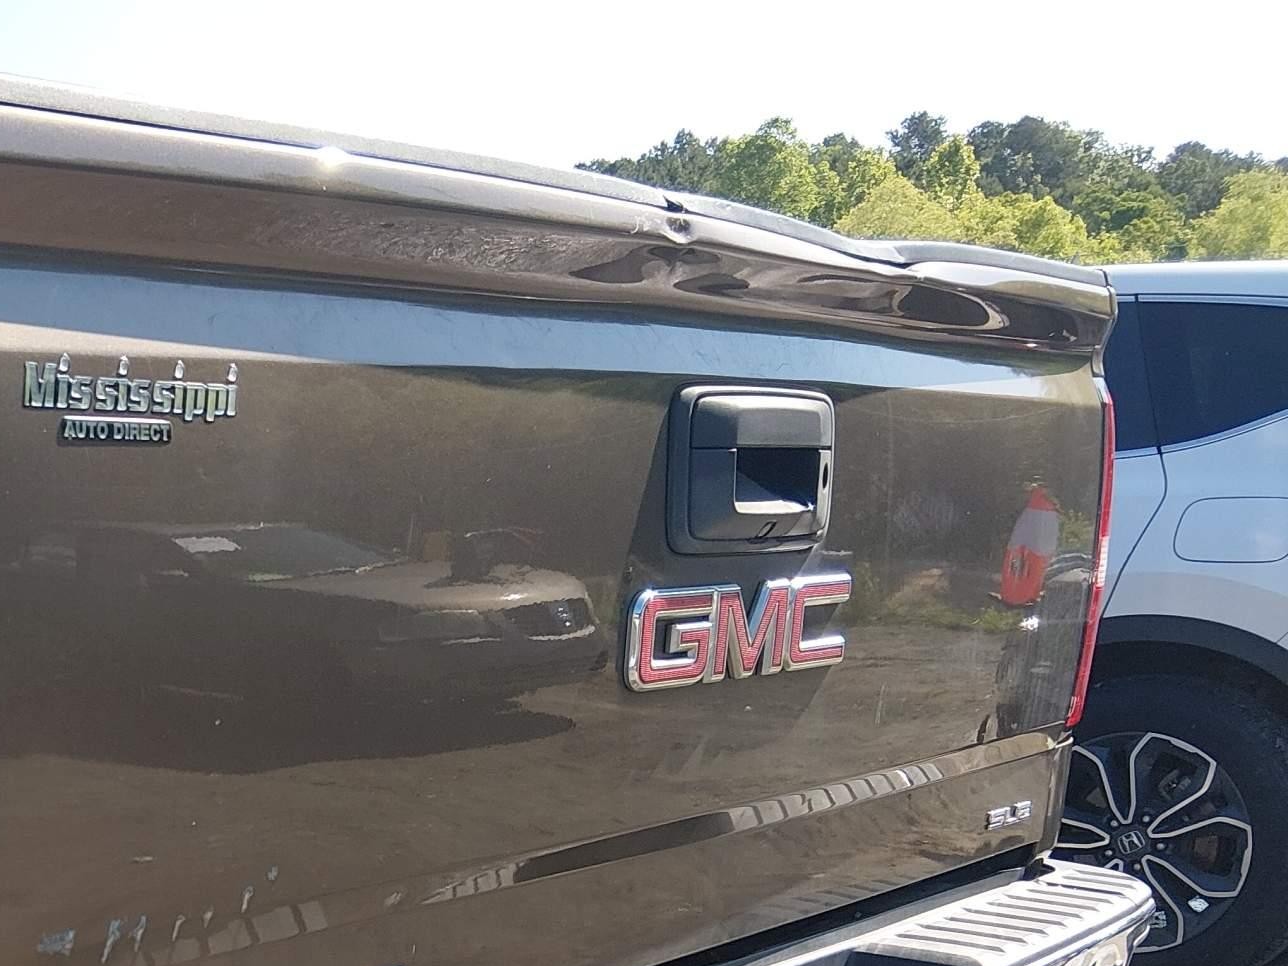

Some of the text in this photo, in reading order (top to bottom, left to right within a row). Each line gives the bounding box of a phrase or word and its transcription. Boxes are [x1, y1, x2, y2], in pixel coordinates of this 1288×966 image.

[23, 352, 238, 422] Mississippi
[63, 421, 171, 443] AUTO DIRECT
[625, 572, 852, 692] GMC
